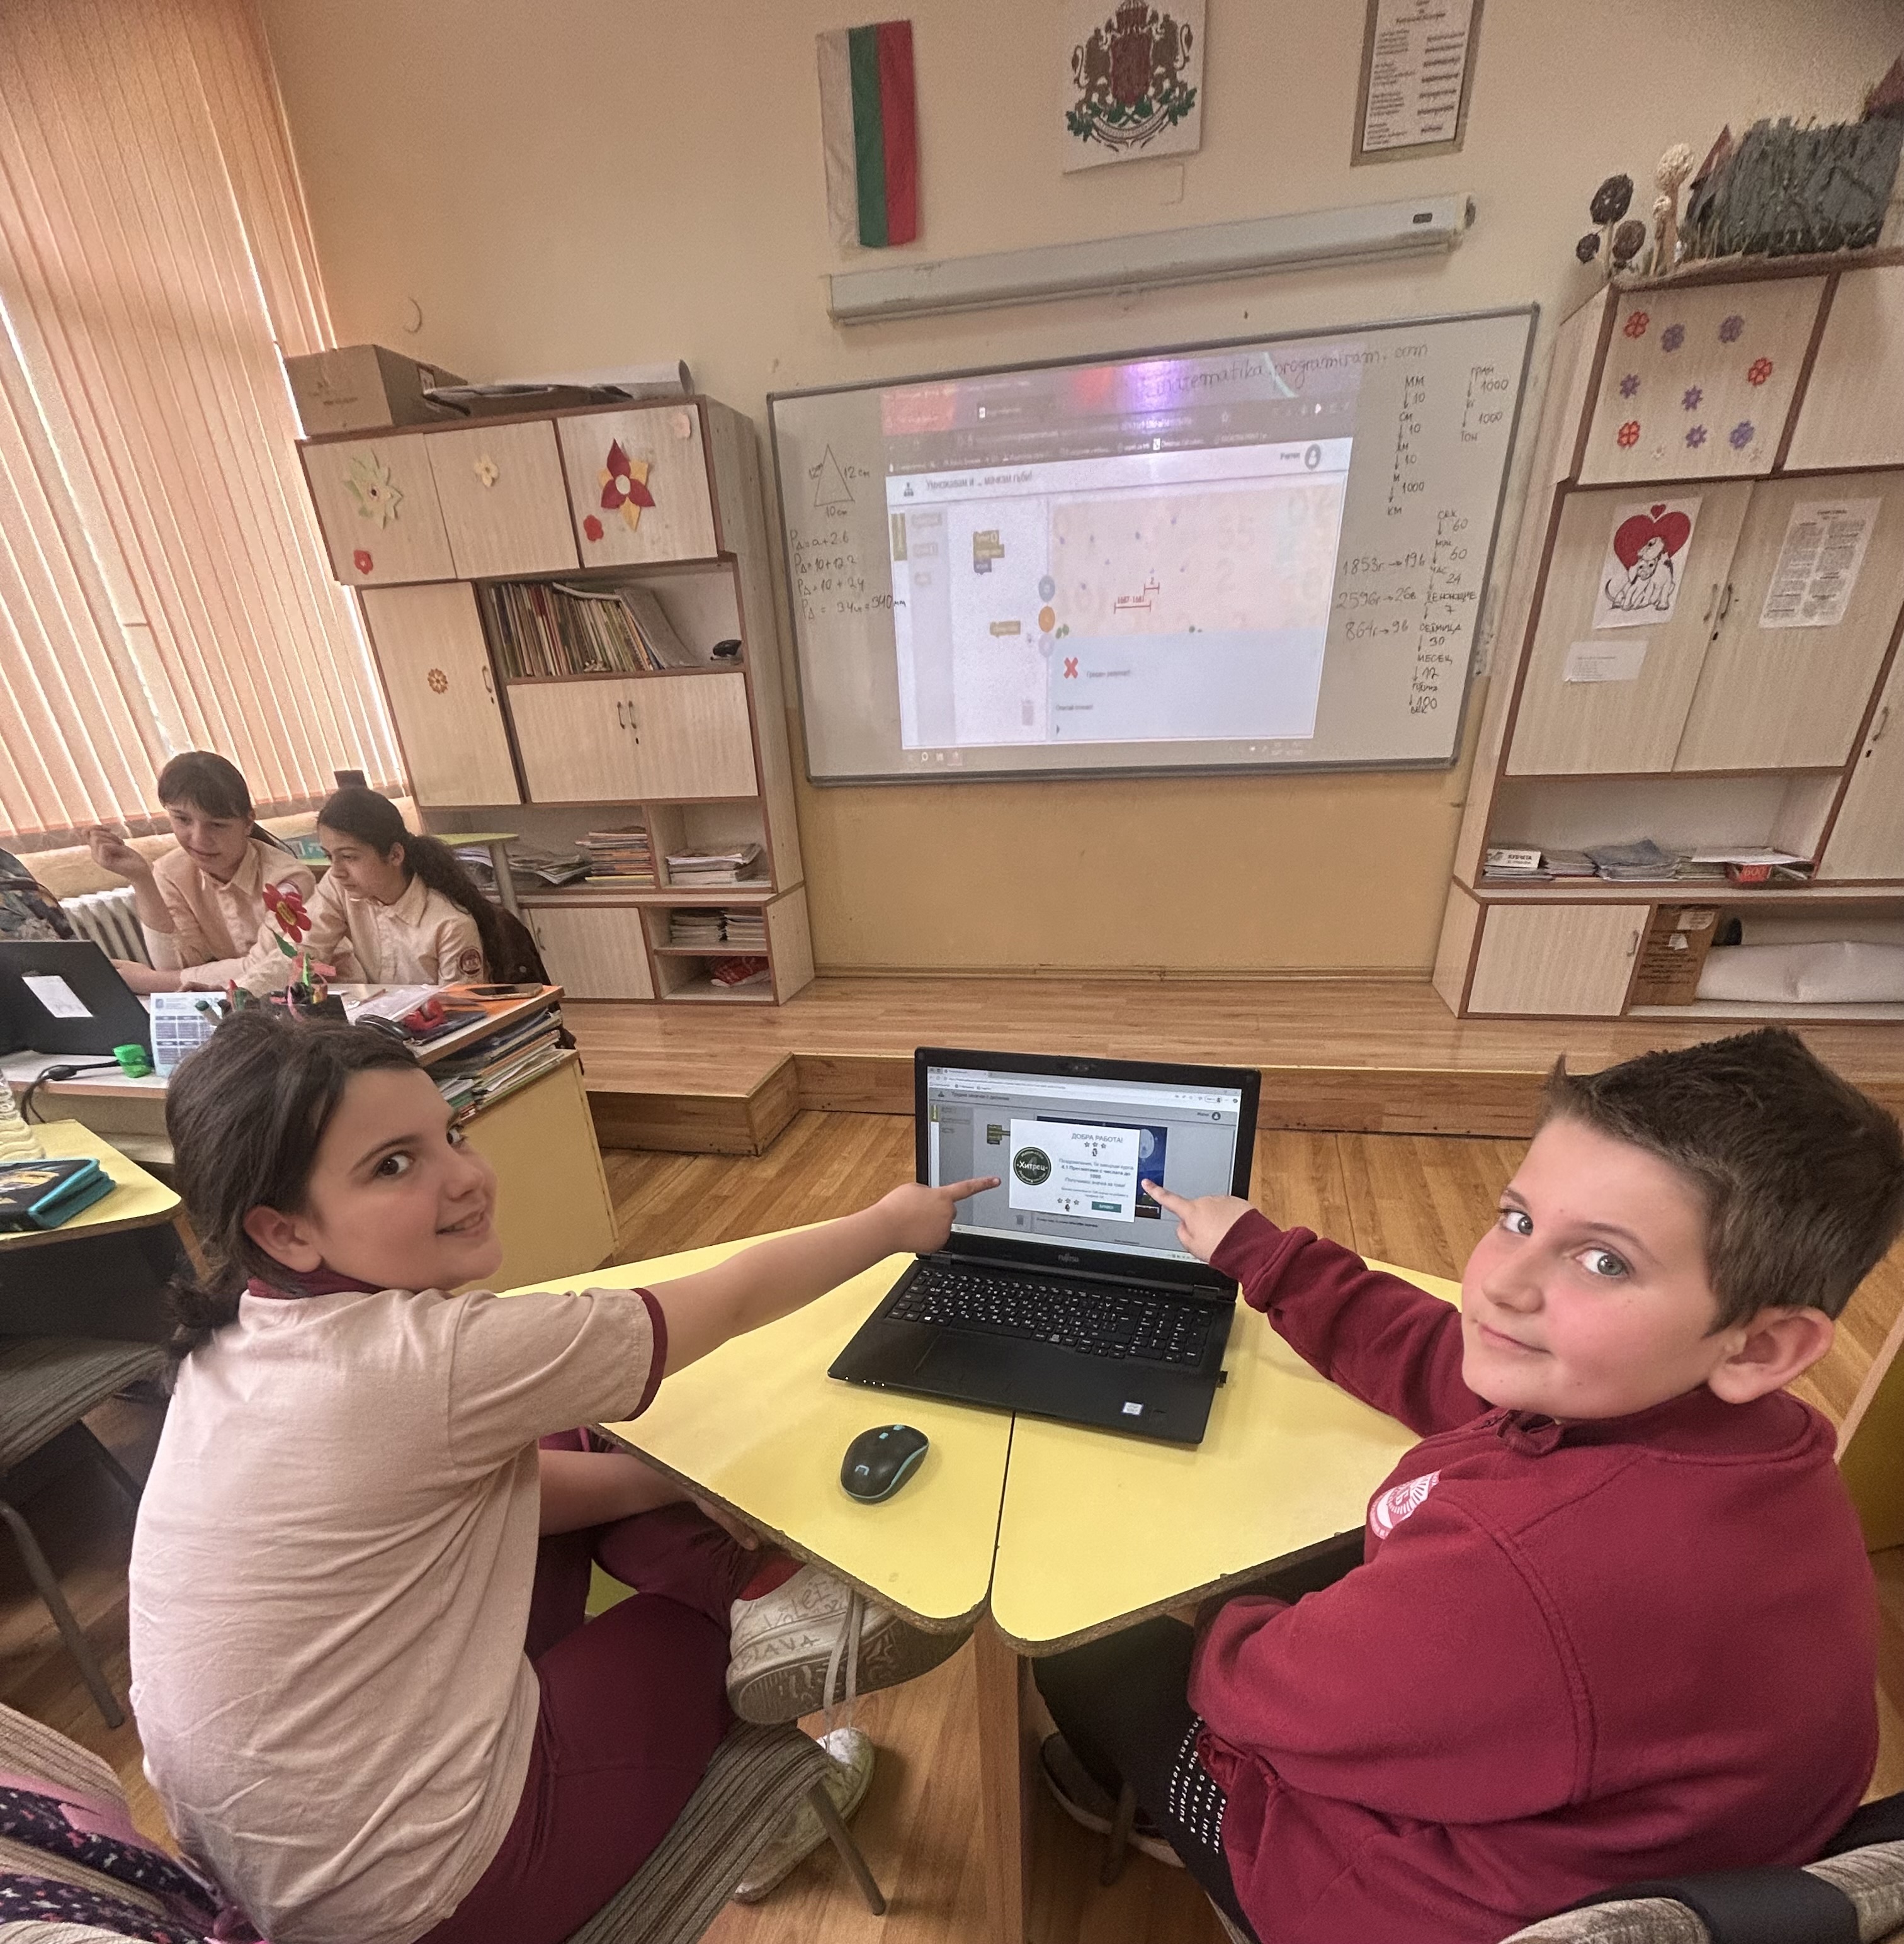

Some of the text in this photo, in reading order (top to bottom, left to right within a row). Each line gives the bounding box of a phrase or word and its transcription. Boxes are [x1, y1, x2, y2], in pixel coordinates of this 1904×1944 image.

[1482, 379, 1509, 393] 1000
[1415, 392, 1425, 404] 10
[1480, 411, 1503, 424] 1000
[1409, 423, 1421, 434] 10
[1405, 455, 1417, 465] 10
[1402, 482, 1425, 494] 1000
[1453, 517, 1468, 532] 60
[1450, 546, 1467, 561] 60
[1445, 604, 1455, 615] 7
[1429, 636, 1445, 647] 30
[1169, 1765, 1181, 1814] fossils
[1179, 1750, 1199, 1823] ous terrains
[1190, 1766, 1207, 1833] osaurs
[1201, 1817, 1211, 1845] into
[1213, 1798, 1227, 1854] explorer
